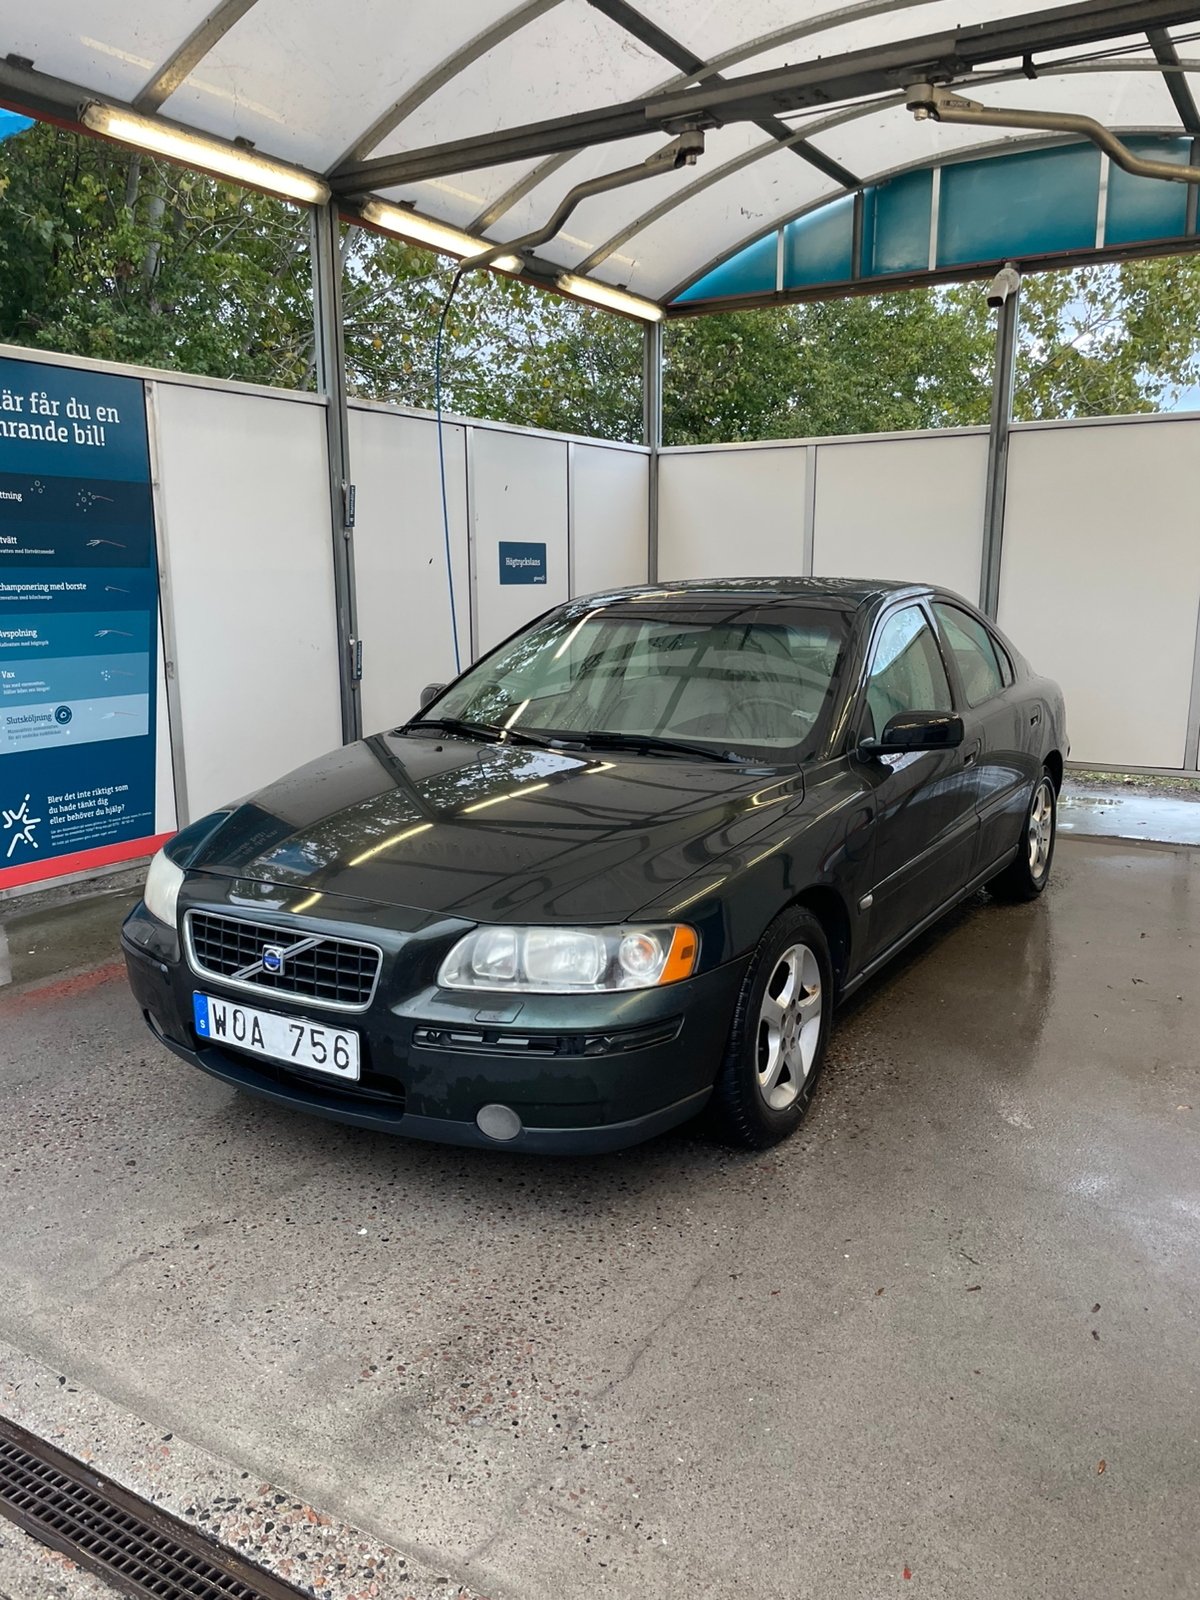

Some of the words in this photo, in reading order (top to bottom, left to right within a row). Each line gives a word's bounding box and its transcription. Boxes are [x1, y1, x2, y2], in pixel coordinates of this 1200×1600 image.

[0, 389, 24, 412] är
[30, 392, 60, 416] får
[66, 396, 91, 420] du
[96, 406, 120, 424] en
[72, 422, 106, 446] bil!
[50, 582, 64, 590] med
[65, 582, 86, 590] borste
[6, 714, 52, 725] Slutsköljning
[64, 793, 75, 801] det
[92, 786, 114, 795] riktigt
[60, 803, 76, 812] hade
[78, 799, 96, 808] tänkt
[97, 798, 108, 806] dig
[50, 816, 65, 825] eller
[67, 811, 94, 822] behöver
[105, 804, 125, 815] hjälp?
[200, 1020, 205, 1029] S
[212, 1003, 265, 1049] WOA
[289, 1024, 350, 1070] 756
